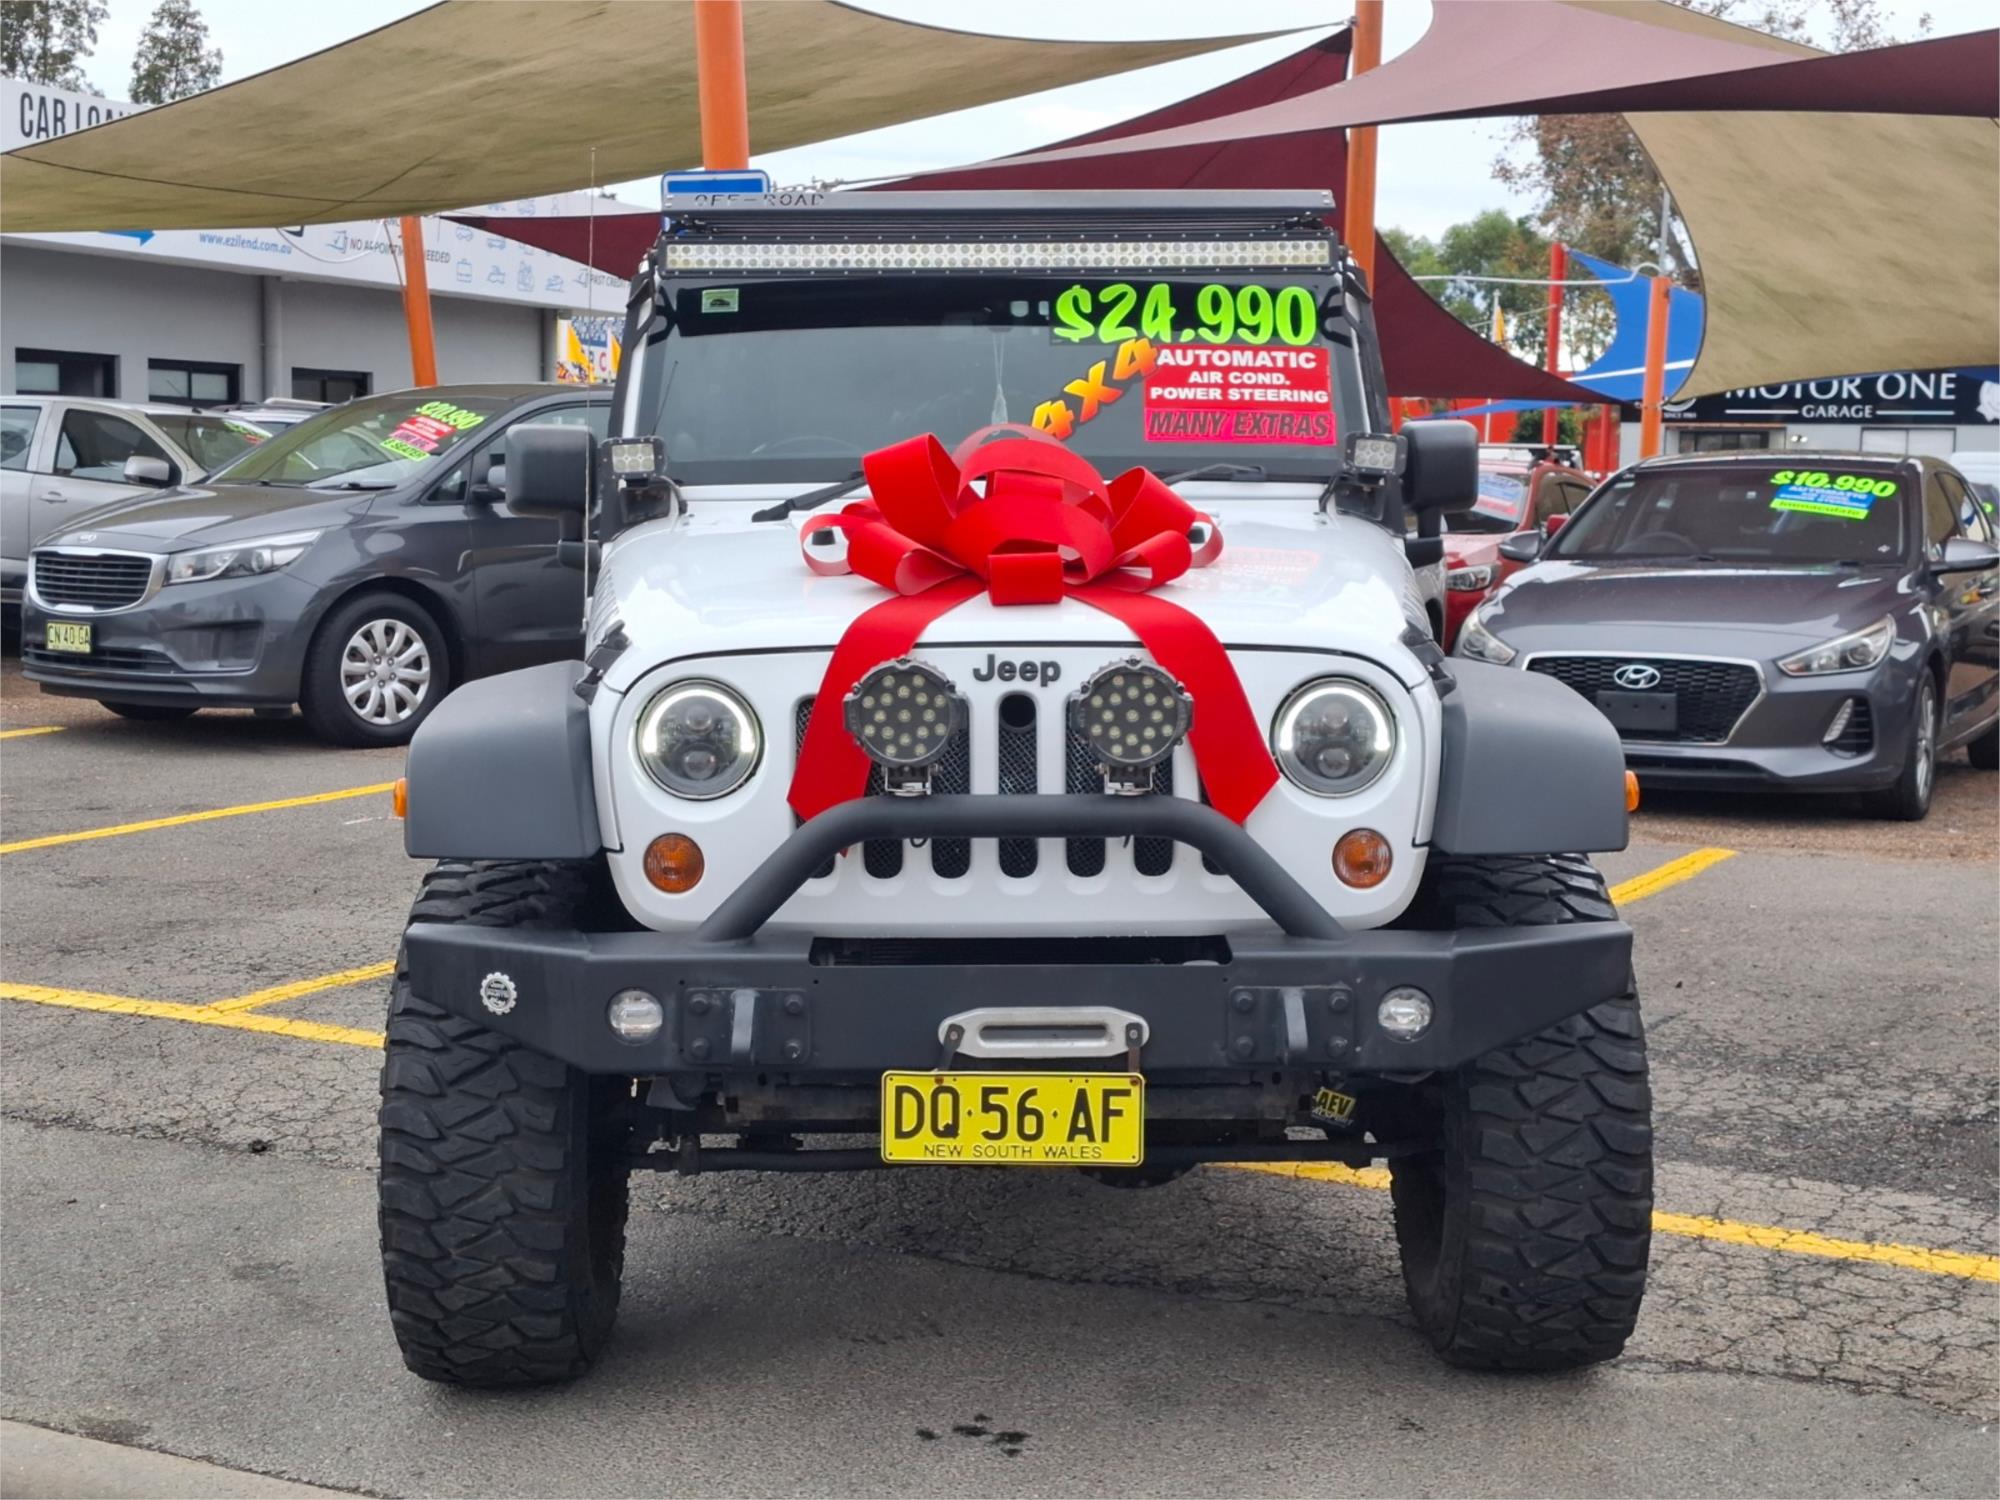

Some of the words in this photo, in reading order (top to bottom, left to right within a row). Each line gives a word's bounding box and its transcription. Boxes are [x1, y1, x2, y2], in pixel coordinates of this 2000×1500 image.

[20, 92, 67, 139] CAR
[198, 232, 292, 255] www.ezilend.com.au
[350, 239, 361, 251] NO
[426, 248, 451, 264] EEDED
[1157, 349, 1317, 369] AUTOMATIC
[1188, 371, 1223, 384] AIR
[1228, 371, 1291, 386] COND.
[1876, 373, 1957, 400] ONE
[1150, 387, 1222, 400] POWER
[1227, 388, 1329, 403] STEERING
[1801, 405, 1873, 419] GARAGE
[1150, 411, 1227, 436] MANY
[1232, 411, 1330, 439] EXTRAS
[972, 653, 1062, 688] Jeep
[924, 1144, 964, 1158] NEW
[972, 1144, 1033, 1159] SOUTH
[1042, 1145, 1103, 1160] WALES
